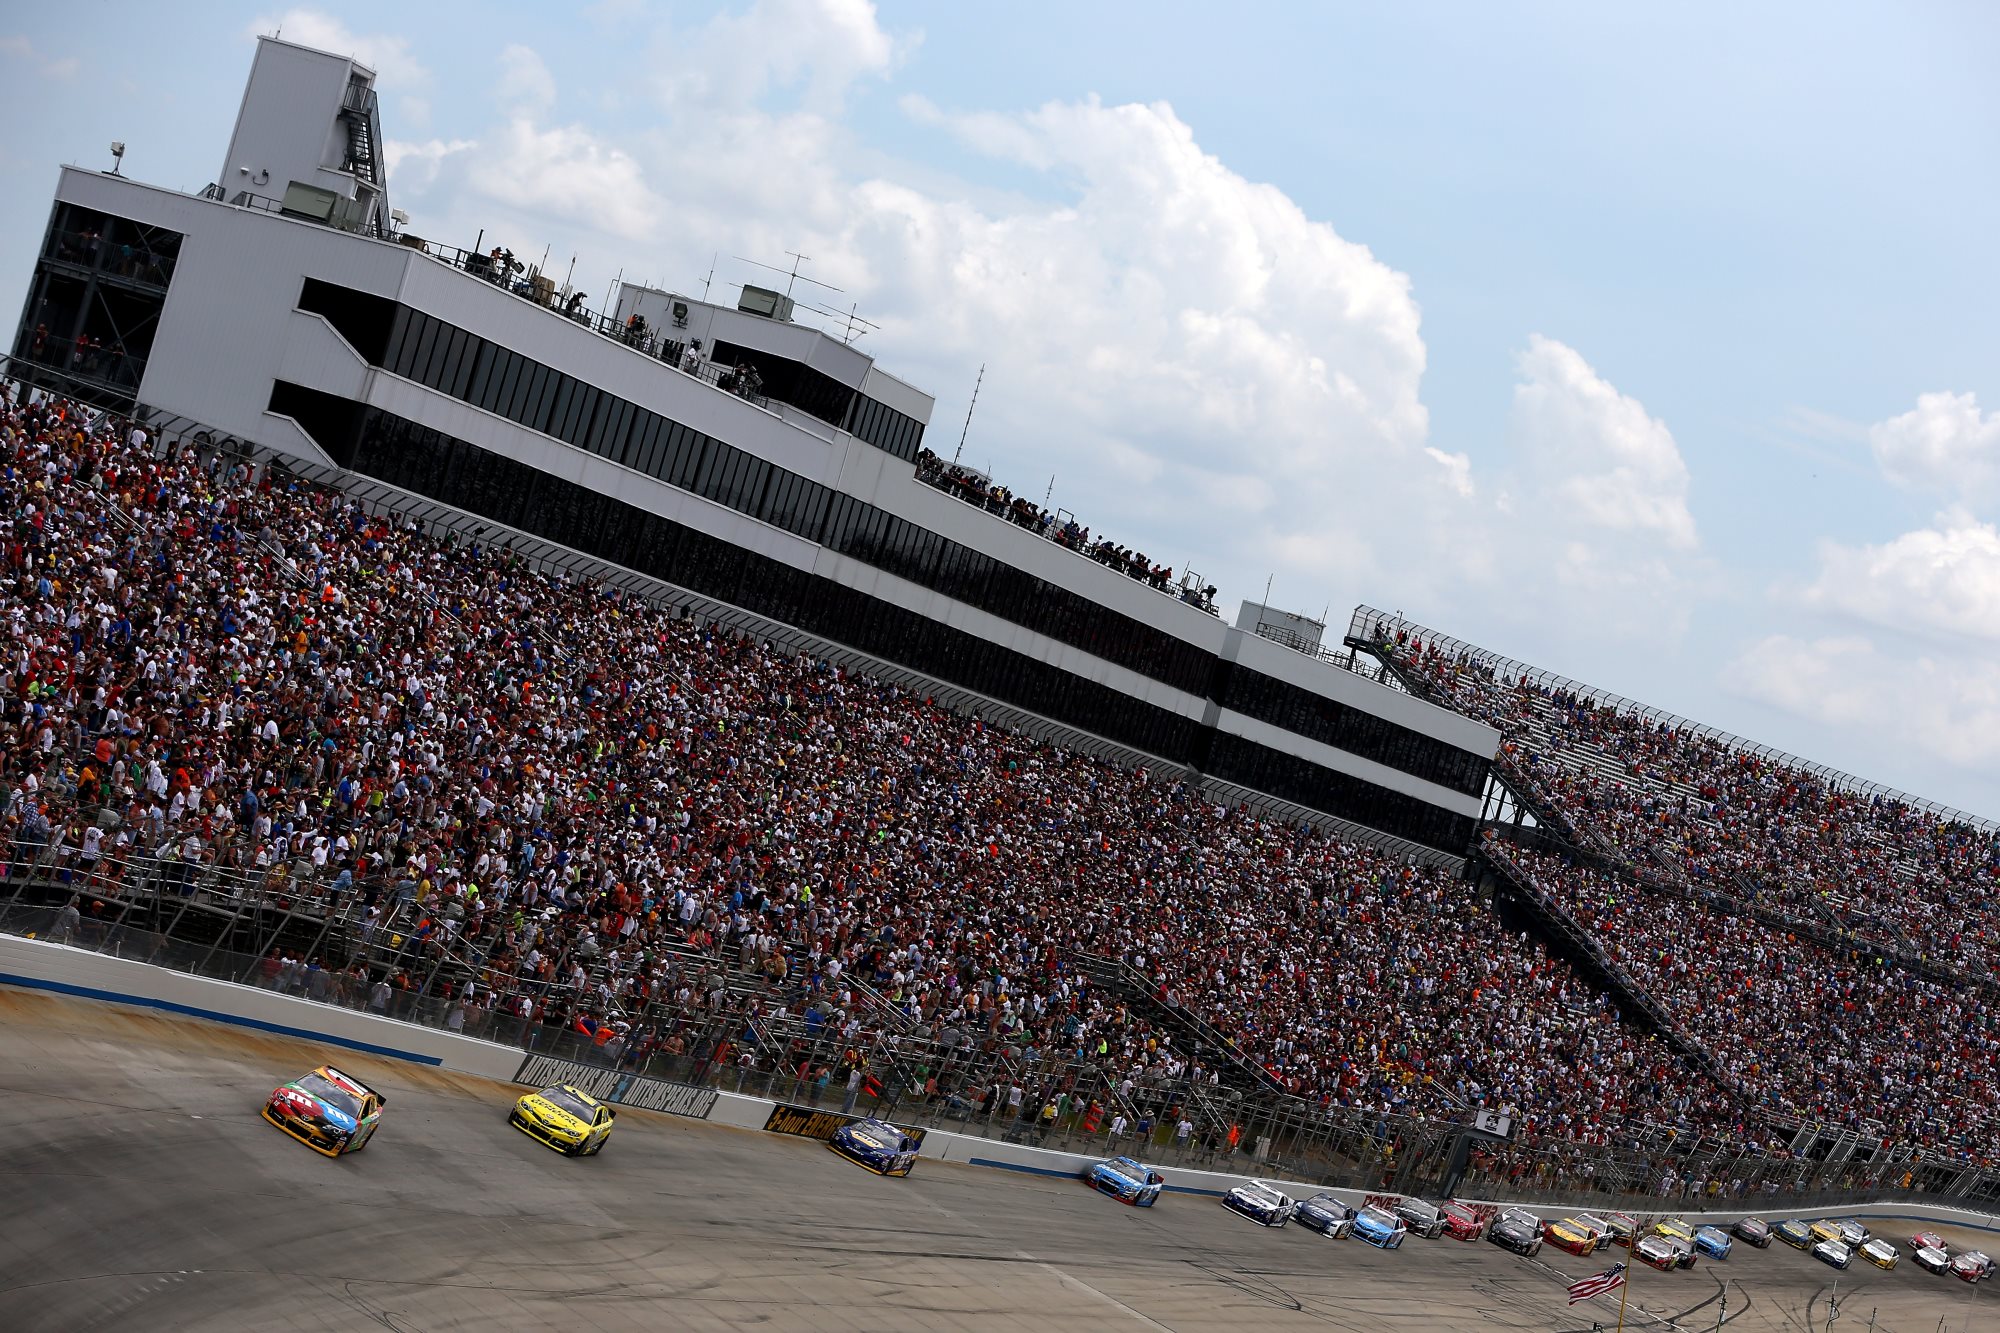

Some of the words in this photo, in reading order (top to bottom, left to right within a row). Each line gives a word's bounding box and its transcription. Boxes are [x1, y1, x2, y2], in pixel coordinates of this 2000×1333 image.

[517, 1055, 621, 1100] AUTISMSPEAKS.ORG
[286, 1091, 312, 1109] m
[326, 1105, 350, 1125] m
[768, 1106, 807, 1133] 5-hour
